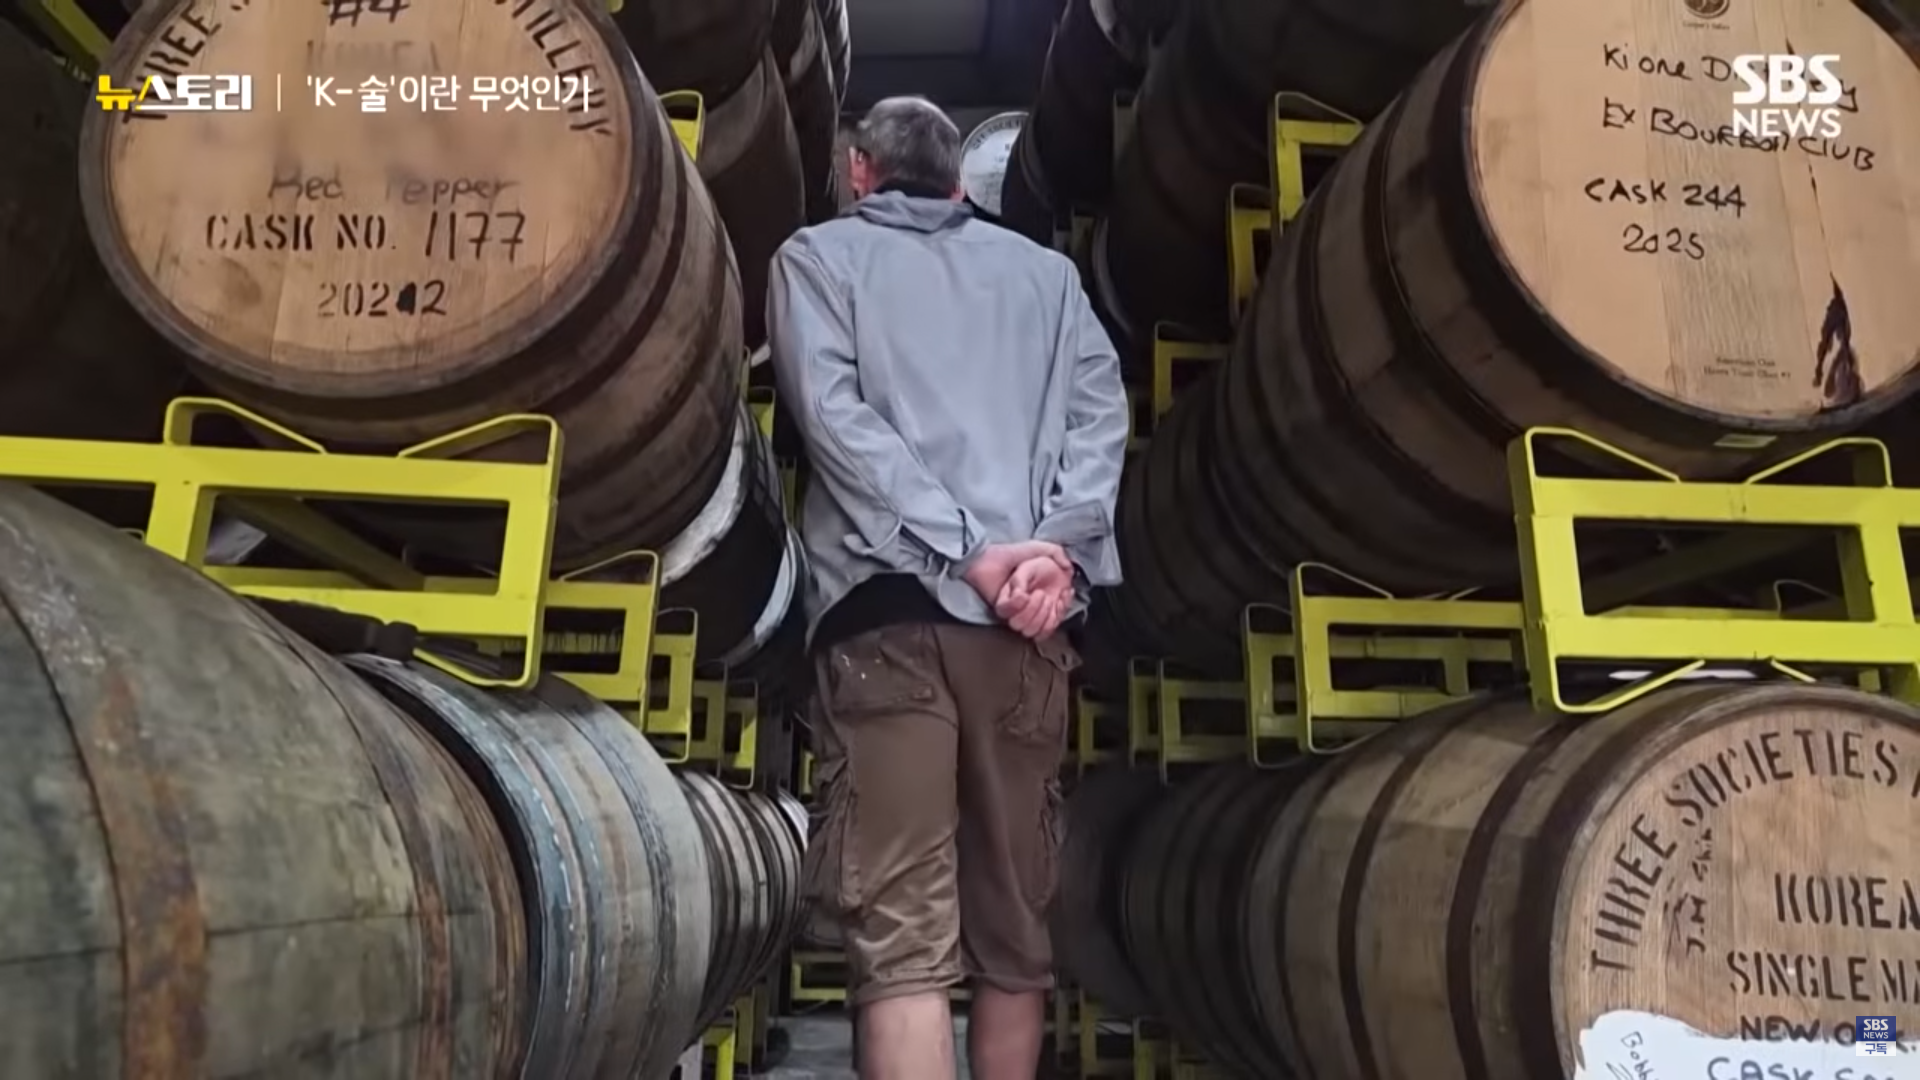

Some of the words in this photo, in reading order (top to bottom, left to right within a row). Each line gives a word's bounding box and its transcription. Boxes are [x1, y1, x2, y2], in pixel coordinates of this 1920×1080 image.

[1585, 178, 1668, 204] CASK
[1683, 184, 1746, 219] 244
[206, 214, 314, 250] CASK
[337, 214, 397, 250] NO.
[425, 210, 526, 263] 1177
[1623, 223, 1705, 260] 2025
[1590, 813, 1678, 972] THREE
[1663, 729, 1898, 827] SOCIETIES
[1727, 950, 1871, 1003] SINGLE
